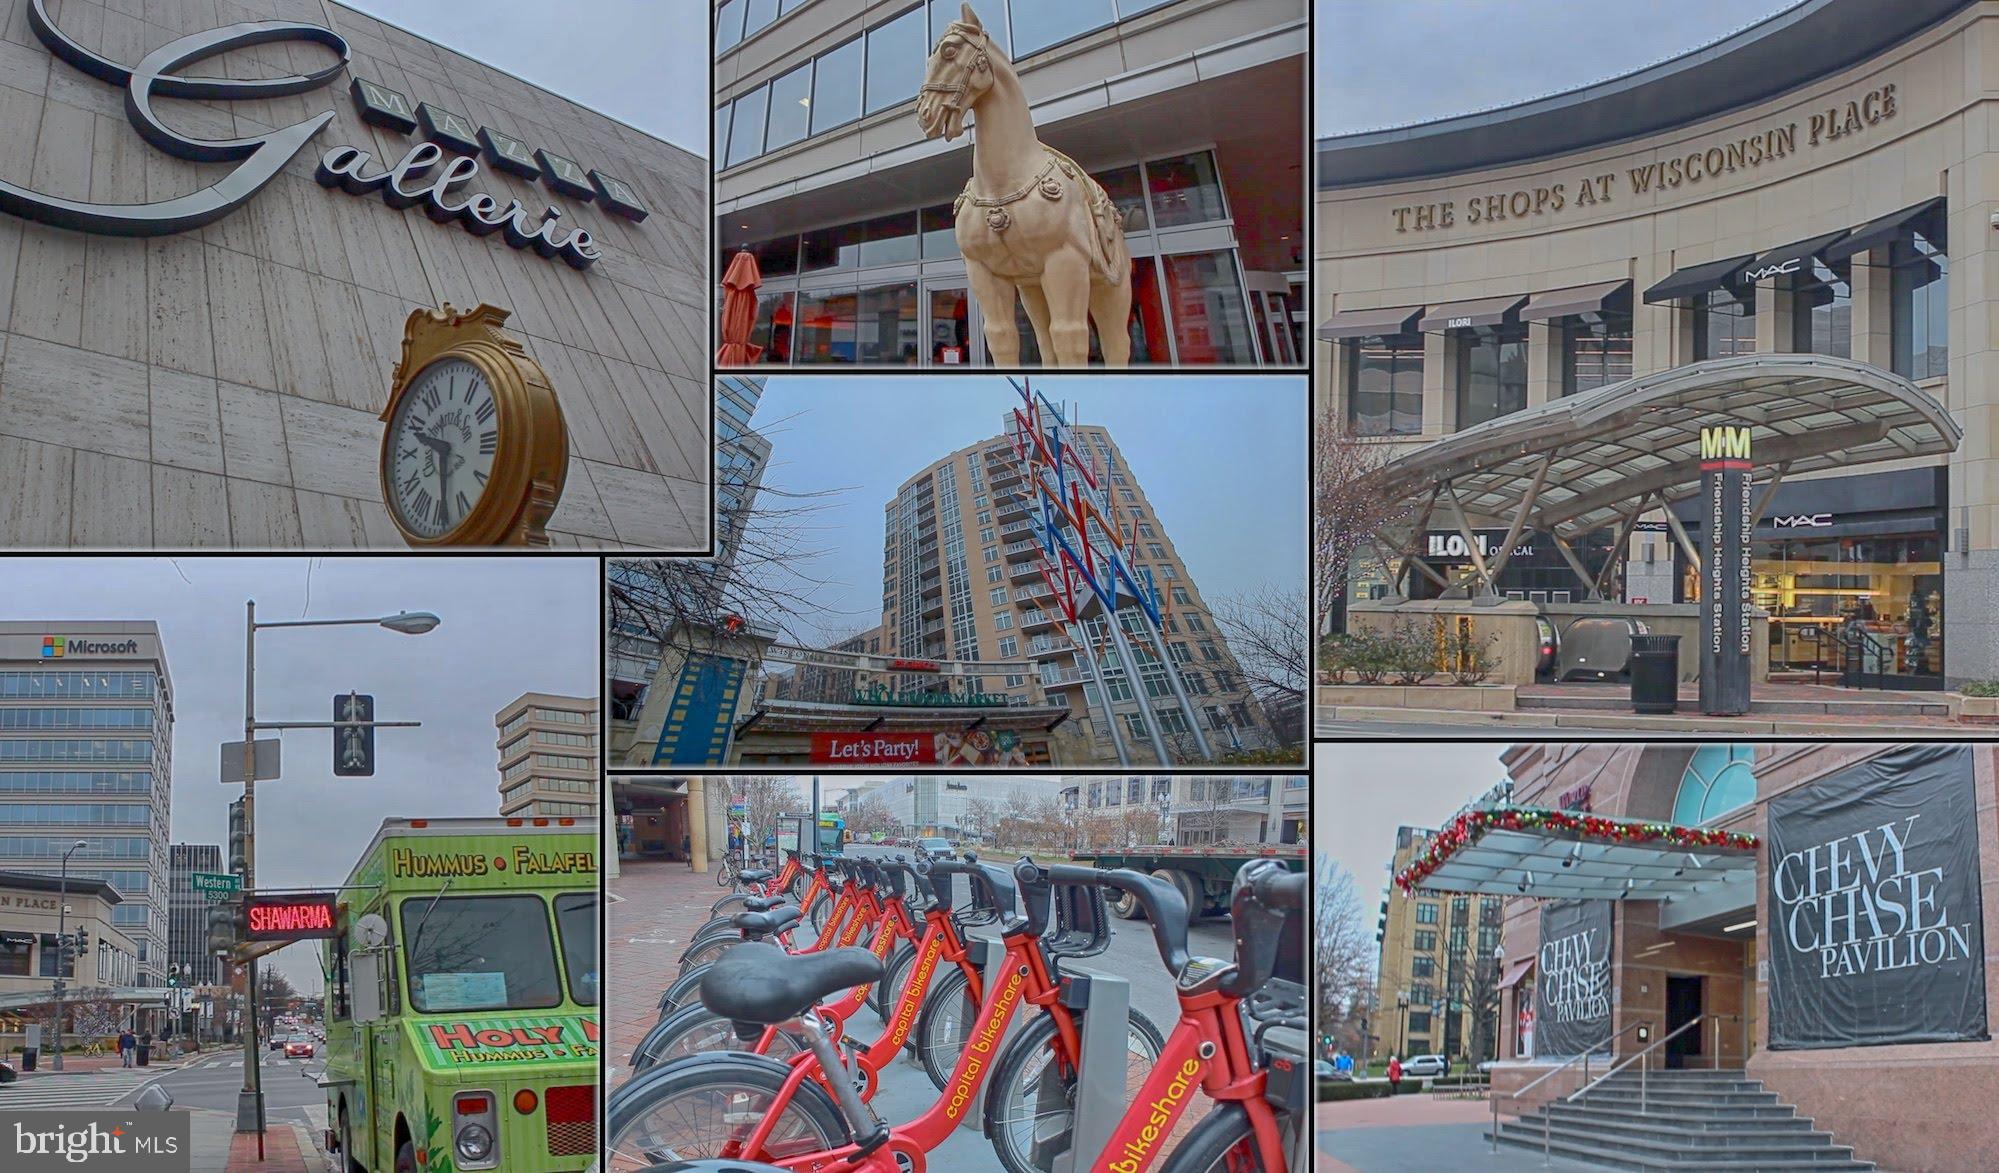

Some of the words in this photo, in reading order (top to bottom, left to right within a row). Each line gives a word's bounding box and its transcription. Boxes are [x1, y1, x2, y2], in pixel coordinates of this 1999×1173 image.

[1392, 201, 1454, 233] THE
[1467, 184, 1565, 225] SHOPS
[1574, 173, 1615, 208] AT
[1625, 122, 1797, 195] WISCONSIN
[1807, 83, 1897, 147] PLACE
[1745, 258, 1801, 283] MAC
[1448, 317, 1472, 329] ILORI
[1712, 473, 1723, 544] Friendship
[1740, 473, 1752, 544] Friendship
[1774, 513, 1833, 529] MAC
[1712, 547, 1723, 600] Heights
[1740, 547, 1751, 600] Heights
[68, 639, 138, 654] Microsoft
[1712, 603, 1723, 653] Station
[1741, 602, 1751, 653] Station
[830, 739, 871, 758] Let's
[874, 739, 919, 760] Party!
[196, 875, 231, 889] Western
[392, 848, 488, 878] HUMMUS
[513, 845, 598, 875] FALAFEL
[1774, 814, 1921, 905] CHEVY
[16, 897, 57, 910] PLACE
[208, 891, 229, 900] 5300
[250, 905, 332, 931] SHAWARMA
[1788, 867, 1948, 953] CHASE
[844, 906, 867, 942] bikeshare
[1541, 928, 1597, 975] CHEVY
[1820, 923, 1971, 979] PAVILION
[1546, 960, 1610, 1006] CHASE
[428, 1023, 565, 1050] HOLY
[892, 1000, 916, 1046] capital
[946, 1055, 982, 1119] capital
[971, 973, 1023, 1054] bikeshare
[450, 1049, 548, 1063] HUMMUS
[1108, 1058, 1200, 1173] bikeshare
